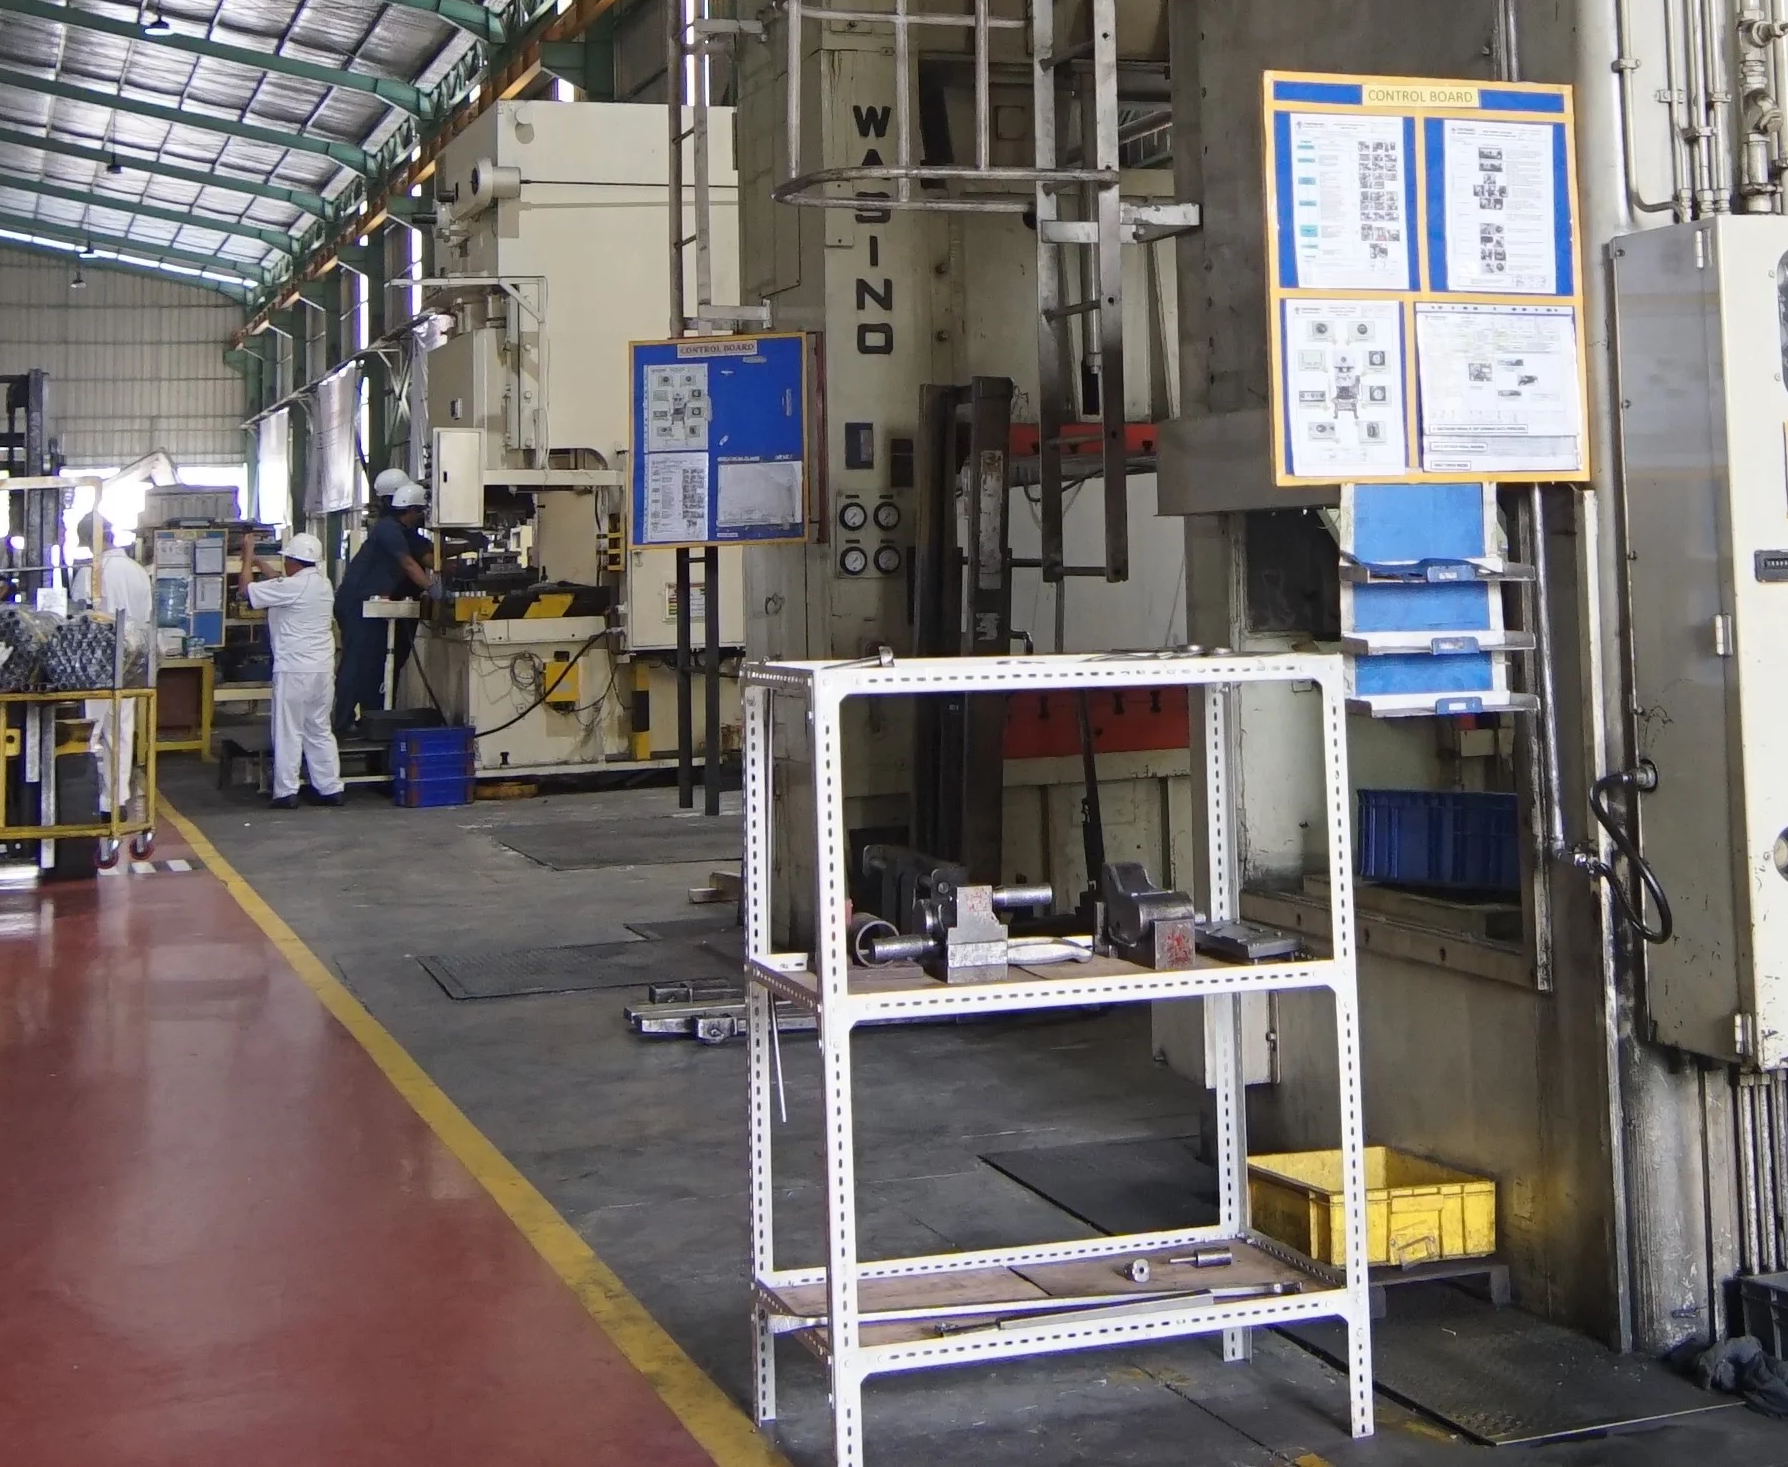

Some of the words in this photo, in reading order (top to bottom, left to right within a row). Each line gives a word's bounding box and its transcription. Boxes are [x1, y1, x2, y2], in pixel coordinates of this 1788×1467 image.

[1368, 89, 1426, 103] CONTROL
[1429, 90, 1473, 103] BOARD
[680, 345, 722, 355] CONTROL
[723, 343, 754, 352] BOARD
